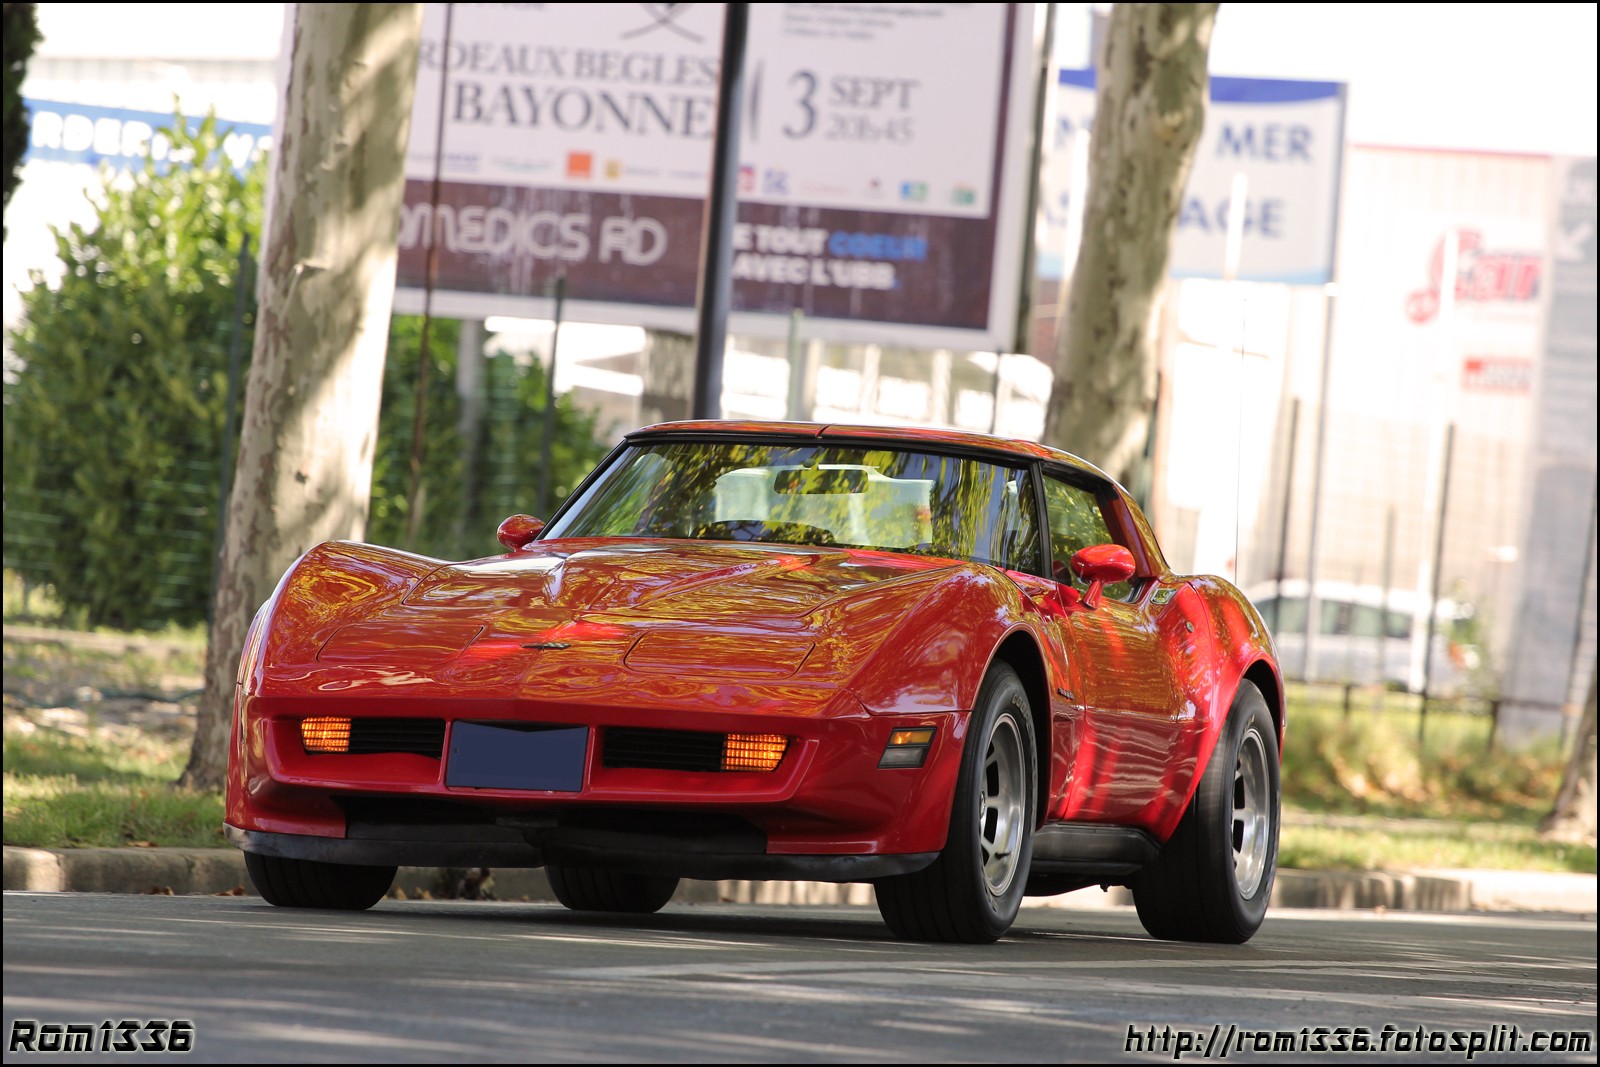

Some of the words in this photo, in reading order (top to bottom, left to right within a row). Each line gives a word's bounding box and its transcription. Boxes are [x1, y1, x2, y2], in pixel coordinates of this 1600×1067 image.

[452, 81, 713, 138] BAYONNE
[783, 69, 818, 139] 3
[829, 76, 920, 111] SEPT
[1215, 121, 1313, 163] MER
[755, 226, 829, 255] TOUT
